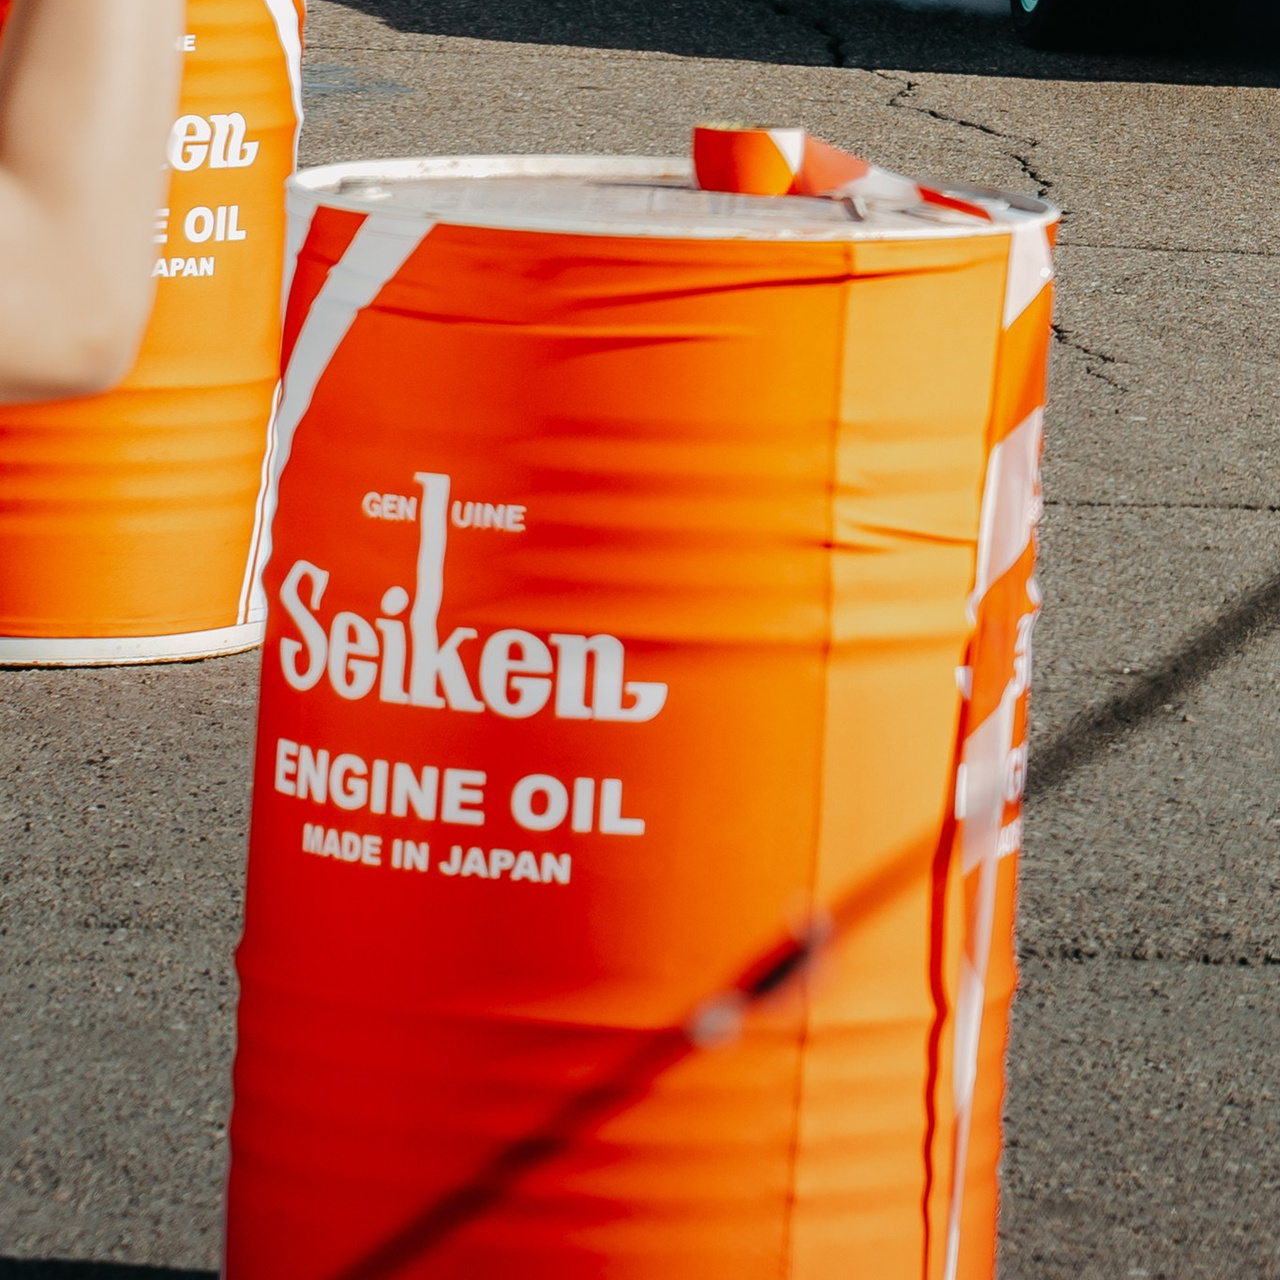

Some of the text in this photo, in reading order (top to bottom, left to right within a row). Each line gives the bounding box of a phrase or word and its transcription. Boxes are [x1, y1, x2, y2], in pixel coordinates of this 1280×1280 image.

[184, 205, 247, 243] OIL
[151, 256, 215, 278] APAN
[280, 471, 668, 723] Seiken
[274, 737, 646, 836] ENGINE OIL
[302, 822, 572, 885] MADE IN JAPAN
